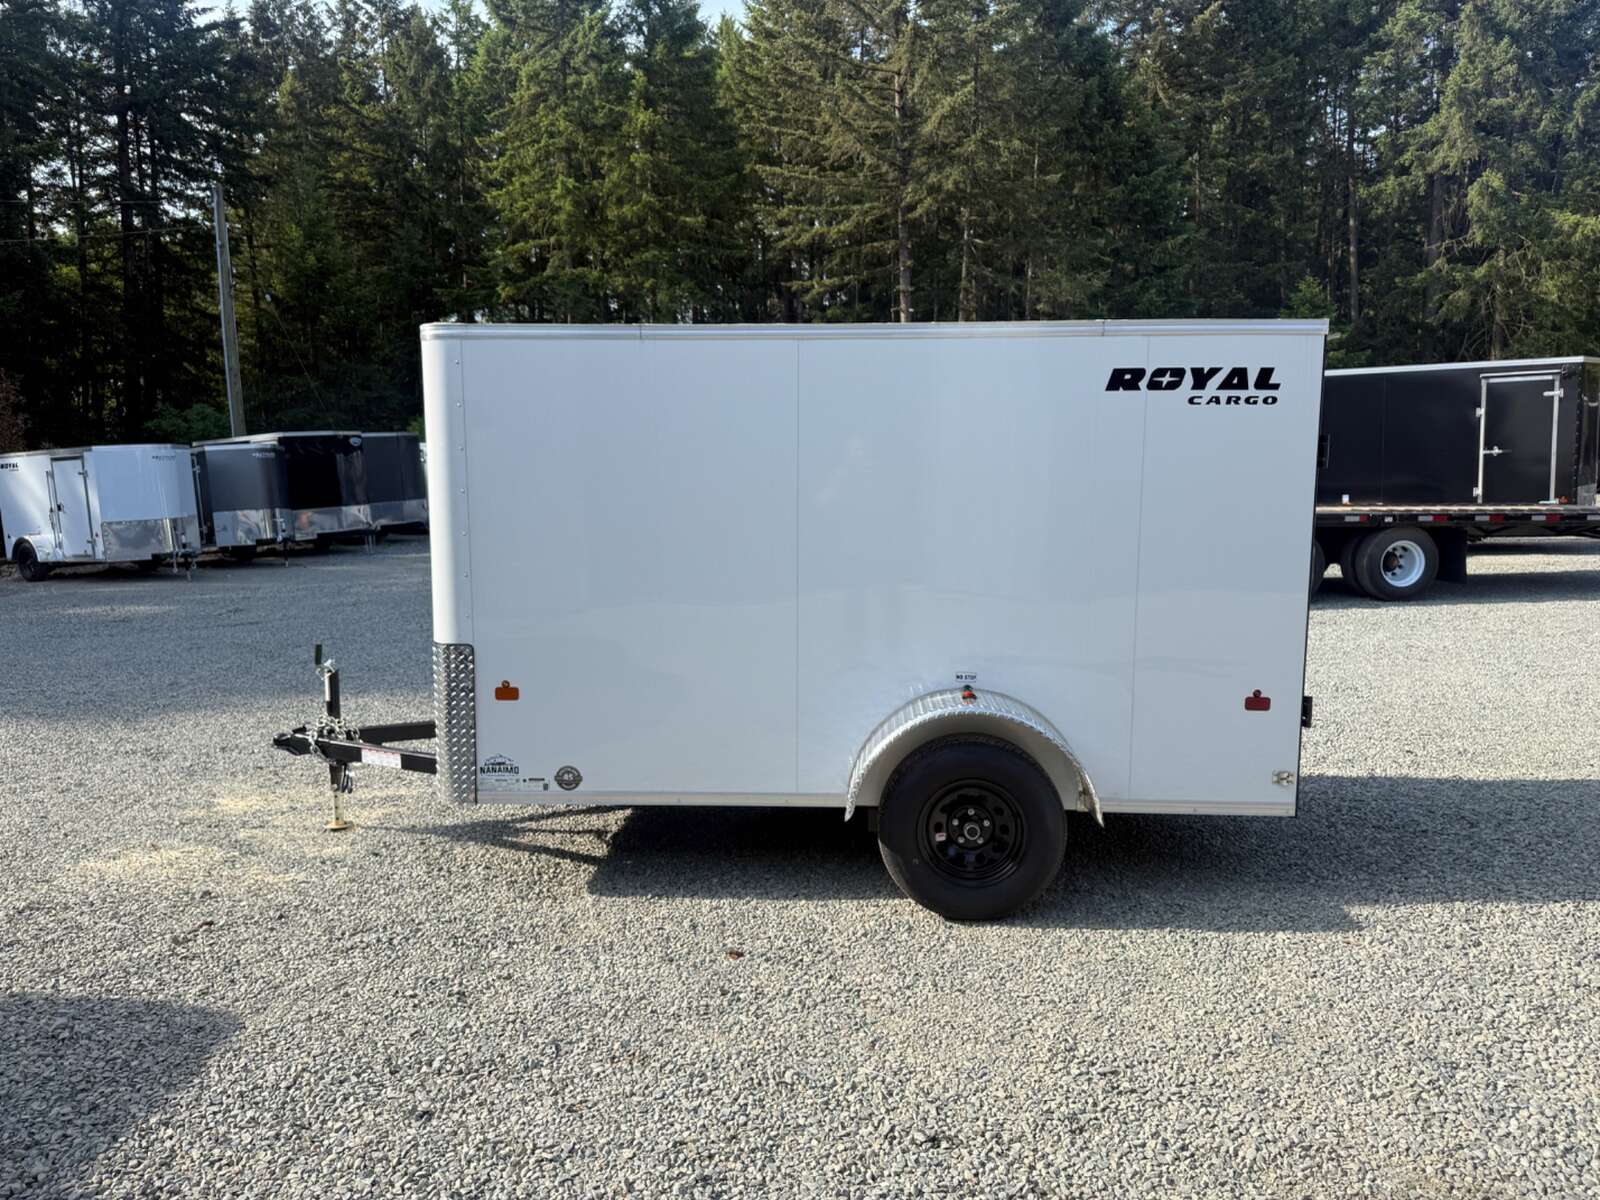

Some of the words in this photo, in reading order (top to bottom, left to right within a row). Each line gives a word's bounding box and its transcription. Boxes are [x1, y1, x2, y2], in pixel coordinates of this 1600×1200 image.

[1105, 366, 1281, 391] ROYAL
[1187, 395, 1278, 405] CARGO
[480, 766, 519, 774] NANAIMO
